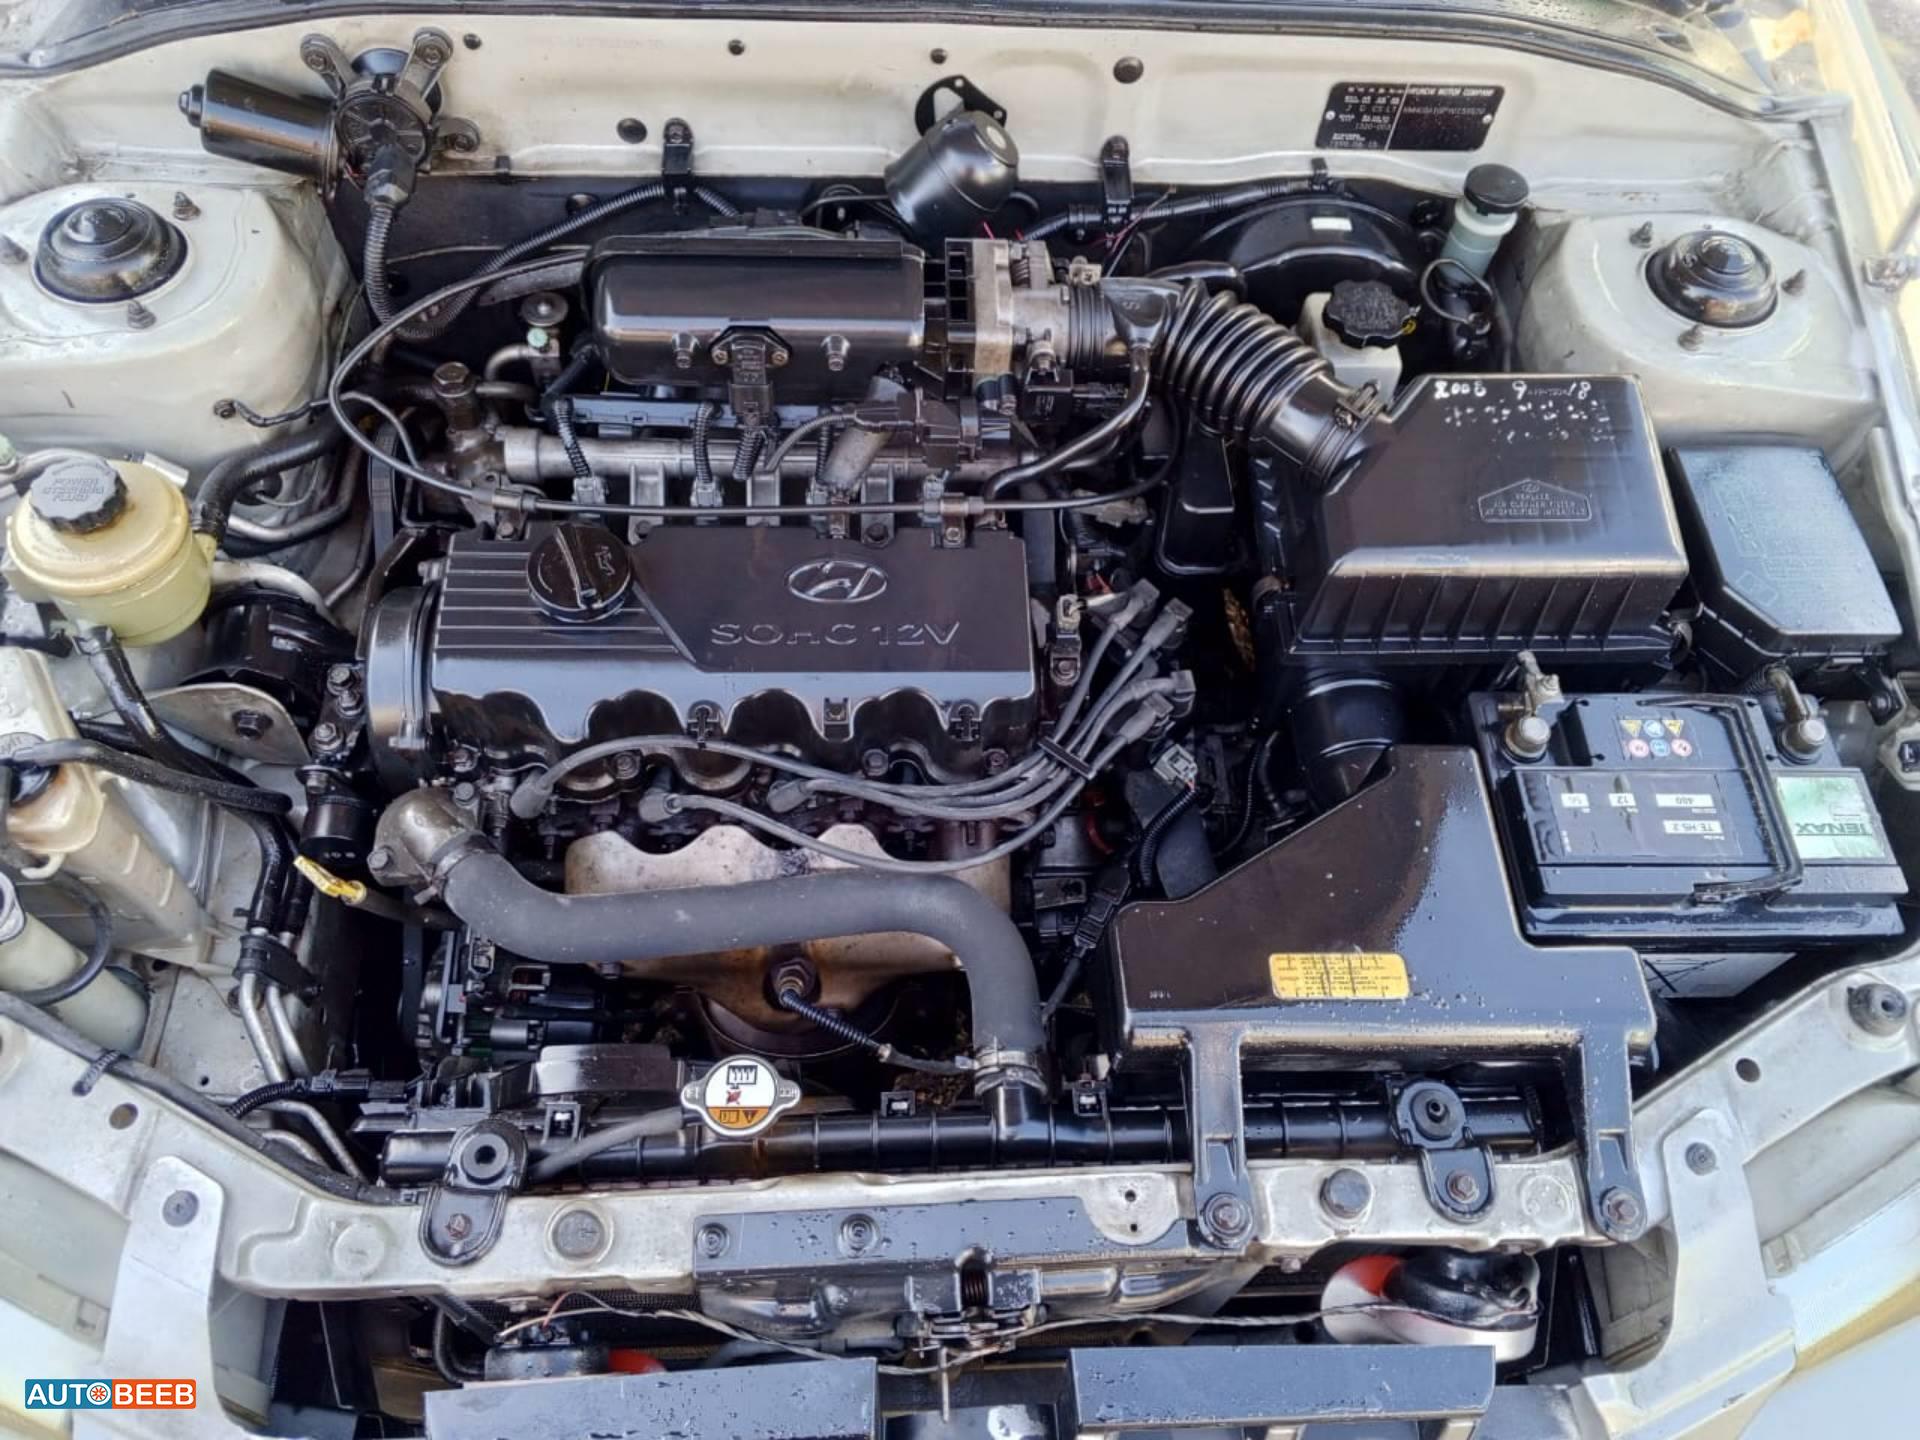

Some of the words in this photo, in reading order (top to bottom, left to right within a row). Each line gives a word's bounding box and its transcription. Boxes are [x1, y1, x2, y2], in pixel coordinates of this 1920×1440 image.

[1438, 87, 1461, 96] MOTOR
[1463, 88, 1495, 97] COMPANY
[710, 623, 857, 645] SOHC
[870, 622, 961, 645] 12V
[1794, 822, 1869, 835] TENAX
